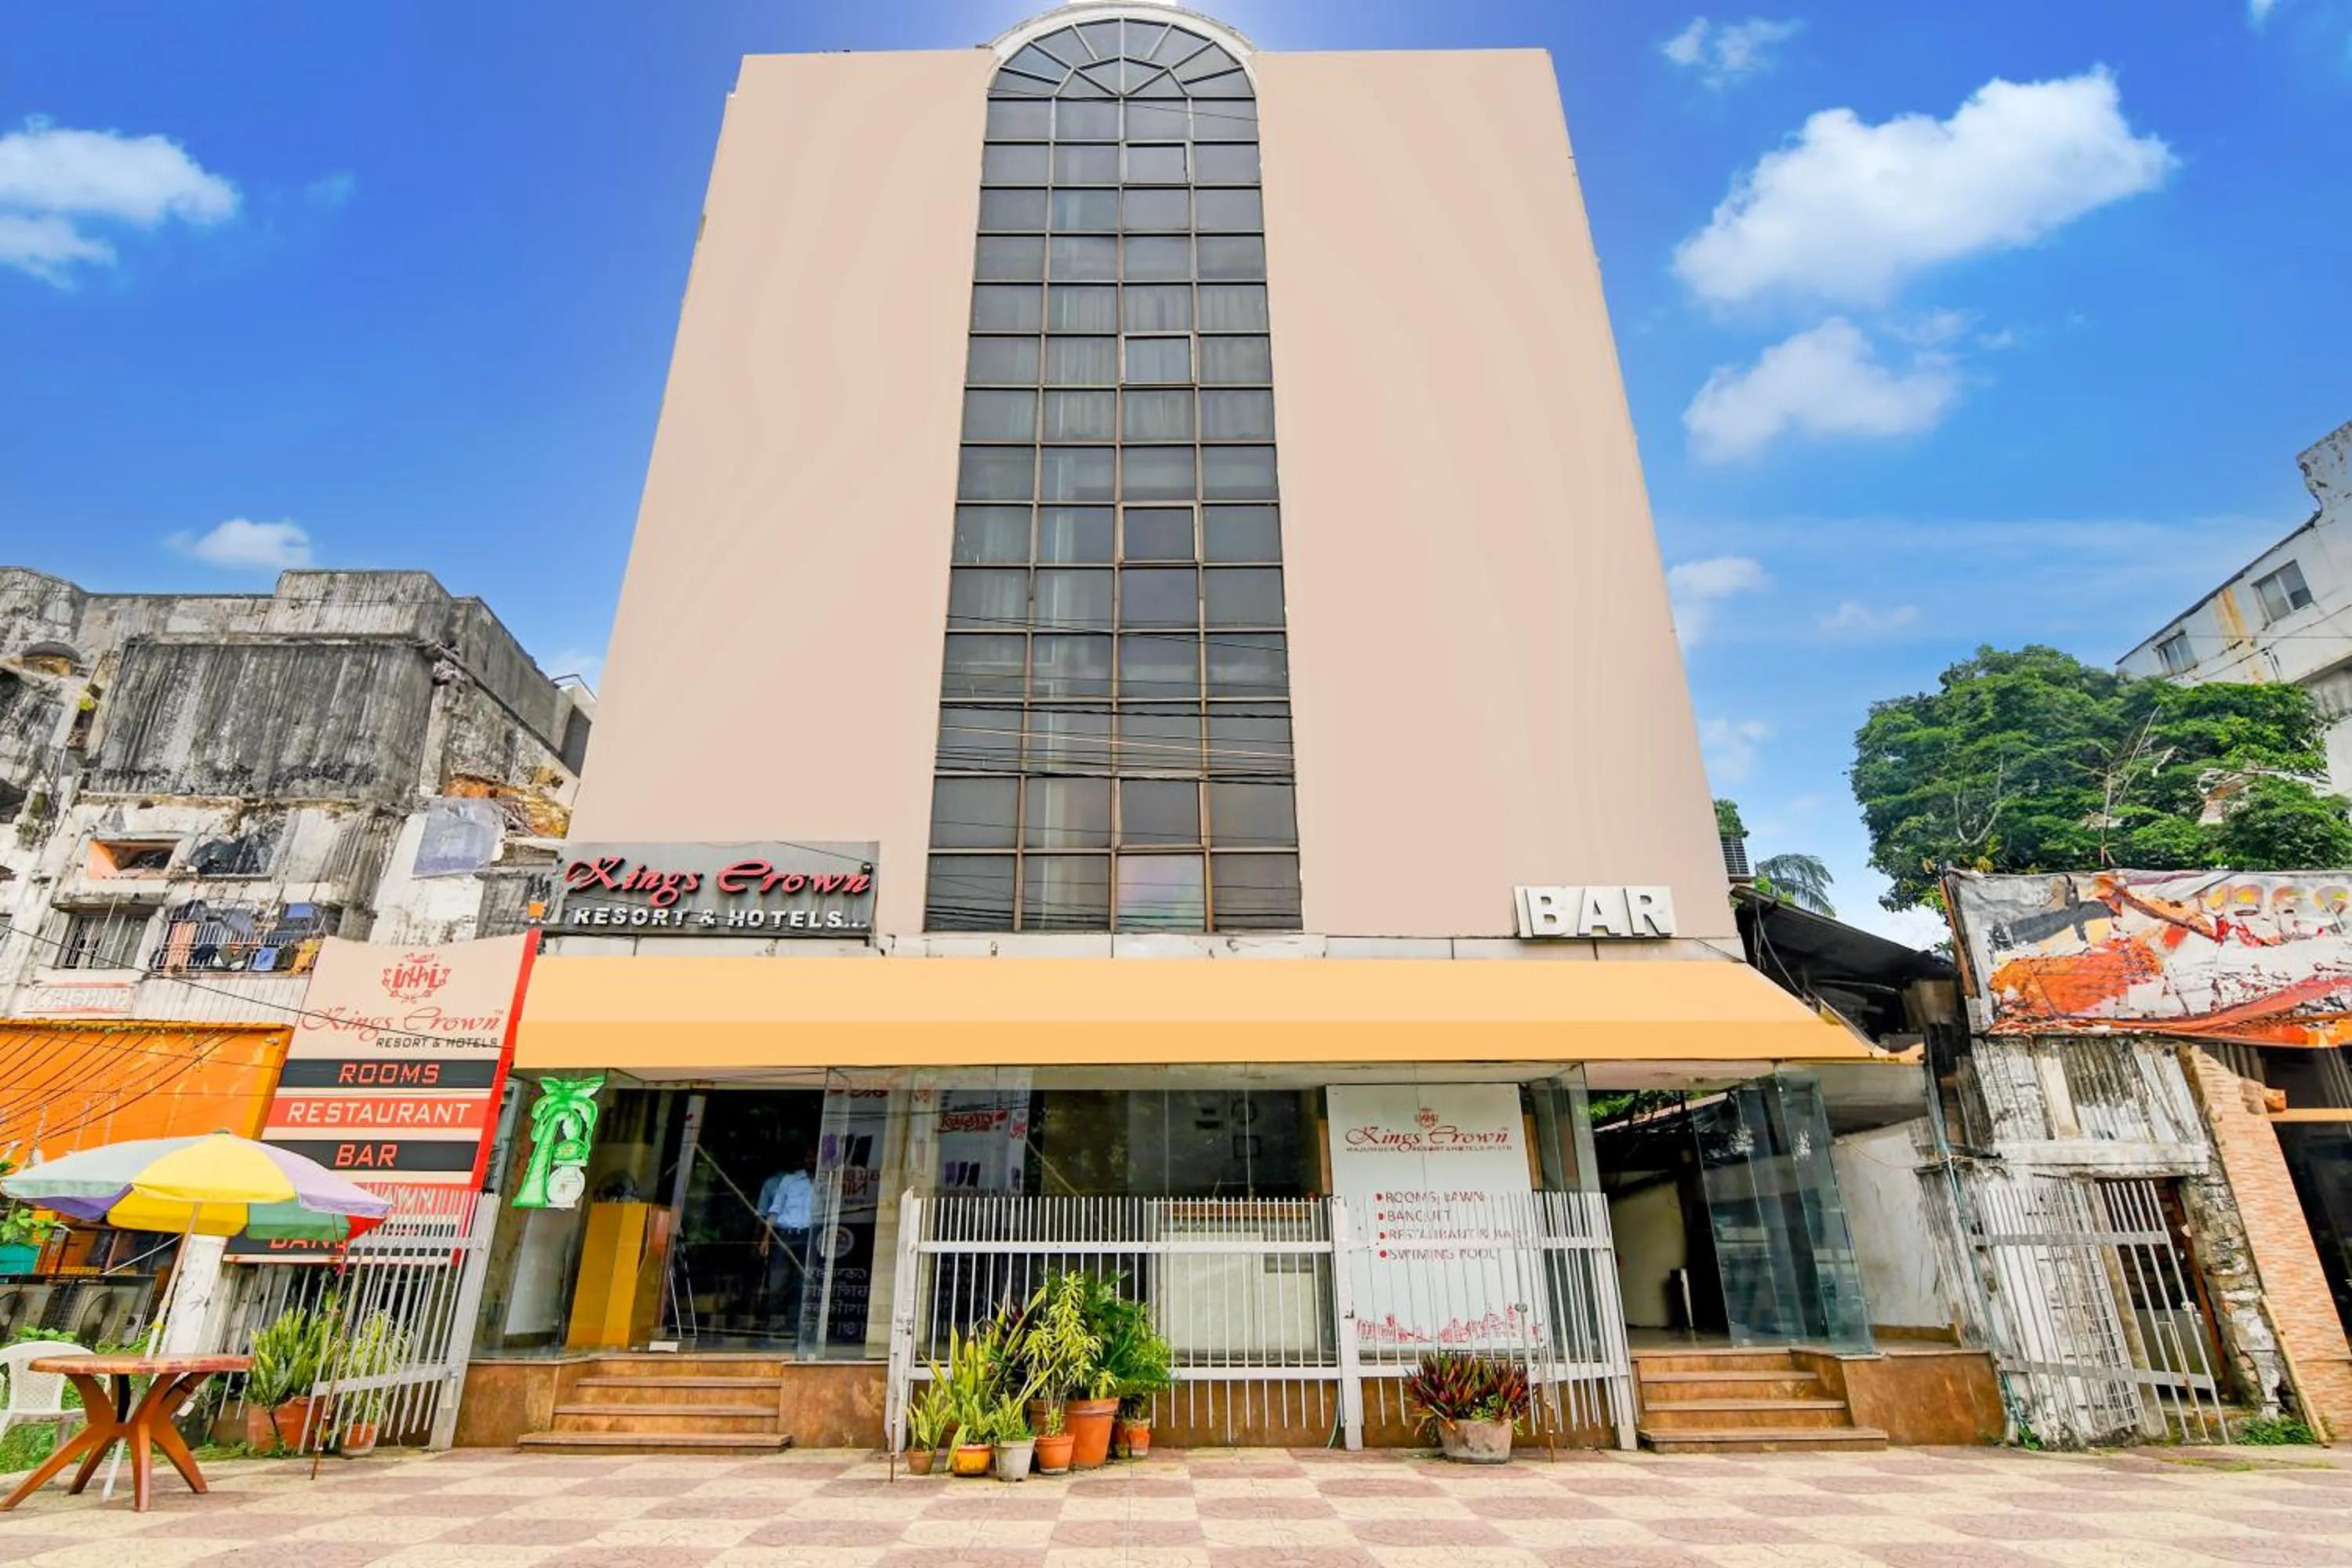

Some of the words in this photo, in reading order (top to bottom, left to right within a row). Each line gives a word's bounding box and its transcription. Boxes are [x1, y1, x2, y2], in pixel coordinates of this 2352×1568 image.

[565, 855, 703, 907] Kings
[716, 858, 874, 895] Crown
[573, 909, 690, 927] RESORT
[699, 909, 716, 927] &
[1523, 885, 1673, 936] BAR
[302, 1007, 392, 1041] Kings
[404, 1006, 500, 1031] Crown
[376, 1036, 429, 1048] RESORT
[446, 1038, 499, 1048] HOTELS
[338, 1064, 440, 1083] ROOMS
[287, 1102, 472, 1123] RESTAURANT
[1345, 1127, 1421, 1153] Kings
[1429, 1125, 1508, 1144] Crown
[335, 1144, 398, 1167] BAR
